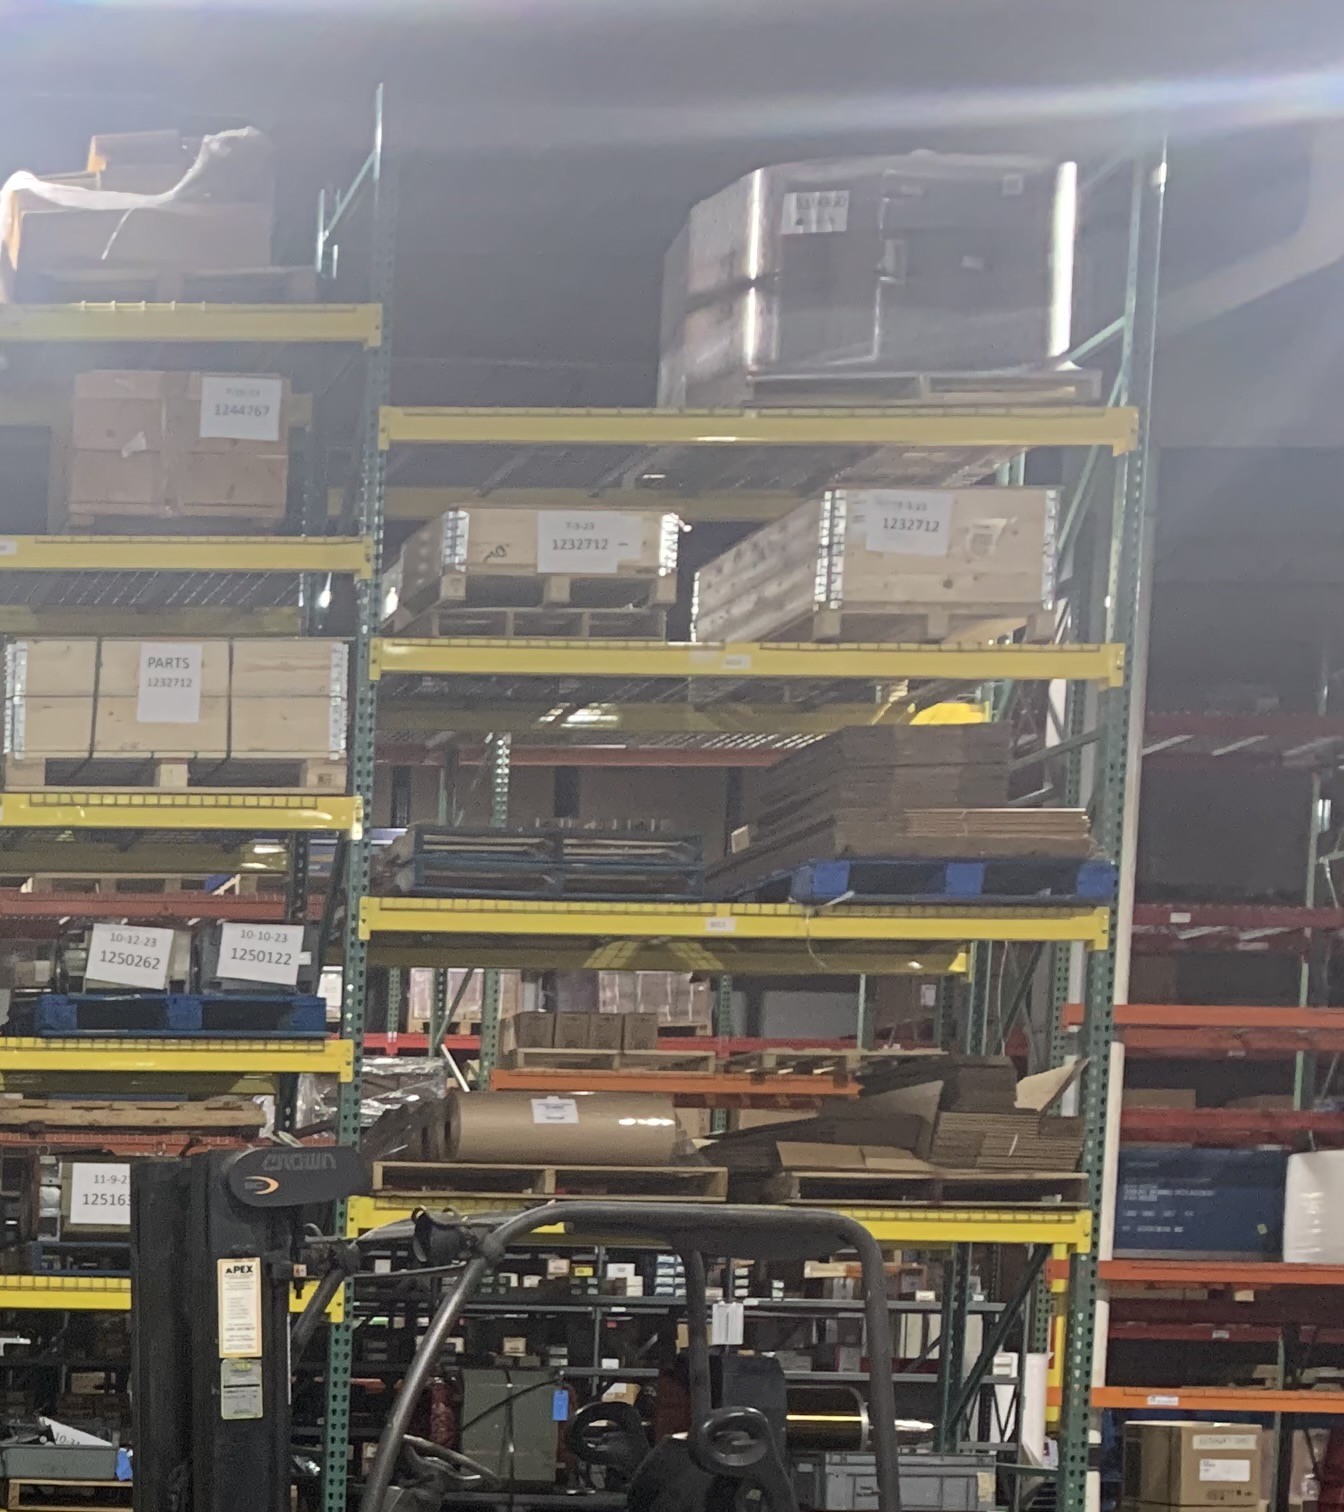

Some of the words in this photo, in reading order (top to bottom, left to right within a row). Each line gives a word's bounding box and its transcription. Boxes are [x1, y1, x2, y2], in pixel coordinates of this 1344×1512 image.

[882, 517, 941, 533] 1232712
[552, 538, 609, 551] 1232712
[147, 656, 191, 670] PARTS
[110, 931, 158, 948] 10-12-23
[240, 928, 289, 943] 10-10-23
[99, 949, 161, 971] 1250262
[230, 947, 292, 966] 1250122
[263, 1152, 337, 1171] CROWN
[93, 1174, 130, 1185] 11-9-2
[225, 1265, 254, 1275] APEX
